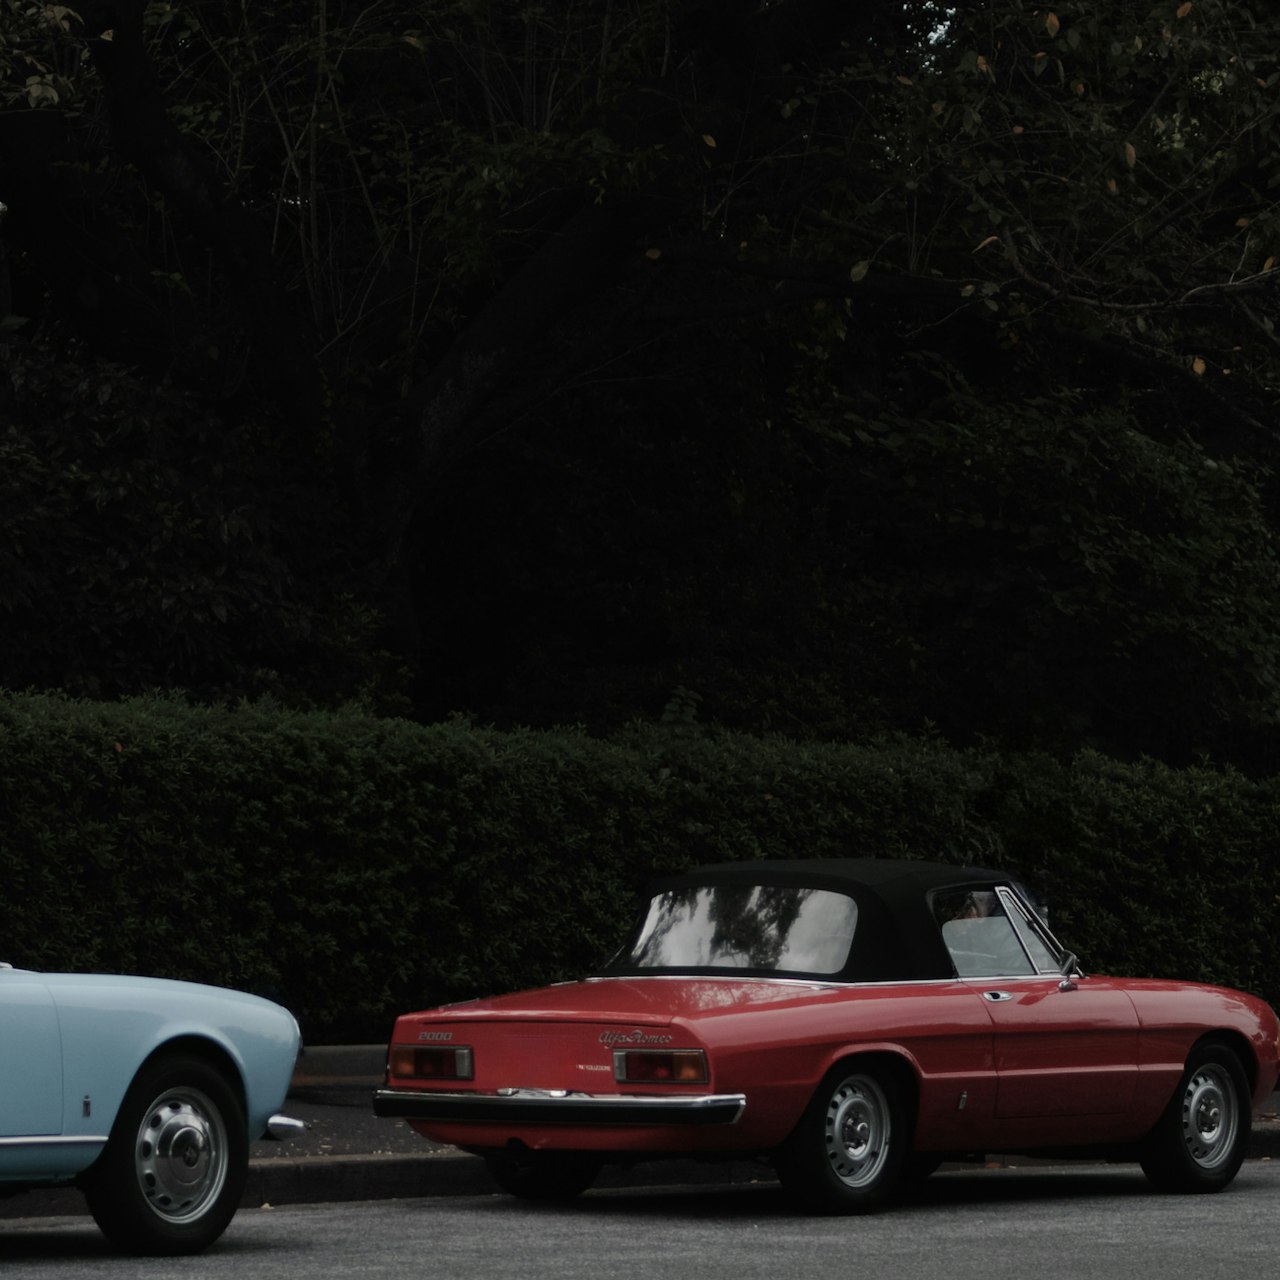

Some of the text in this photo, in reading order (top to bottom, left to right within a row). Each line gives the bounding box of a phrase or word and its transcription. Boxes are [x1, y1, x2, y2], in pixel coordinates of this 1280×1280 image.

[418, 1031, 454, 1041] 2000
[598, 1029, 673, 1050] Alfa Romeo
